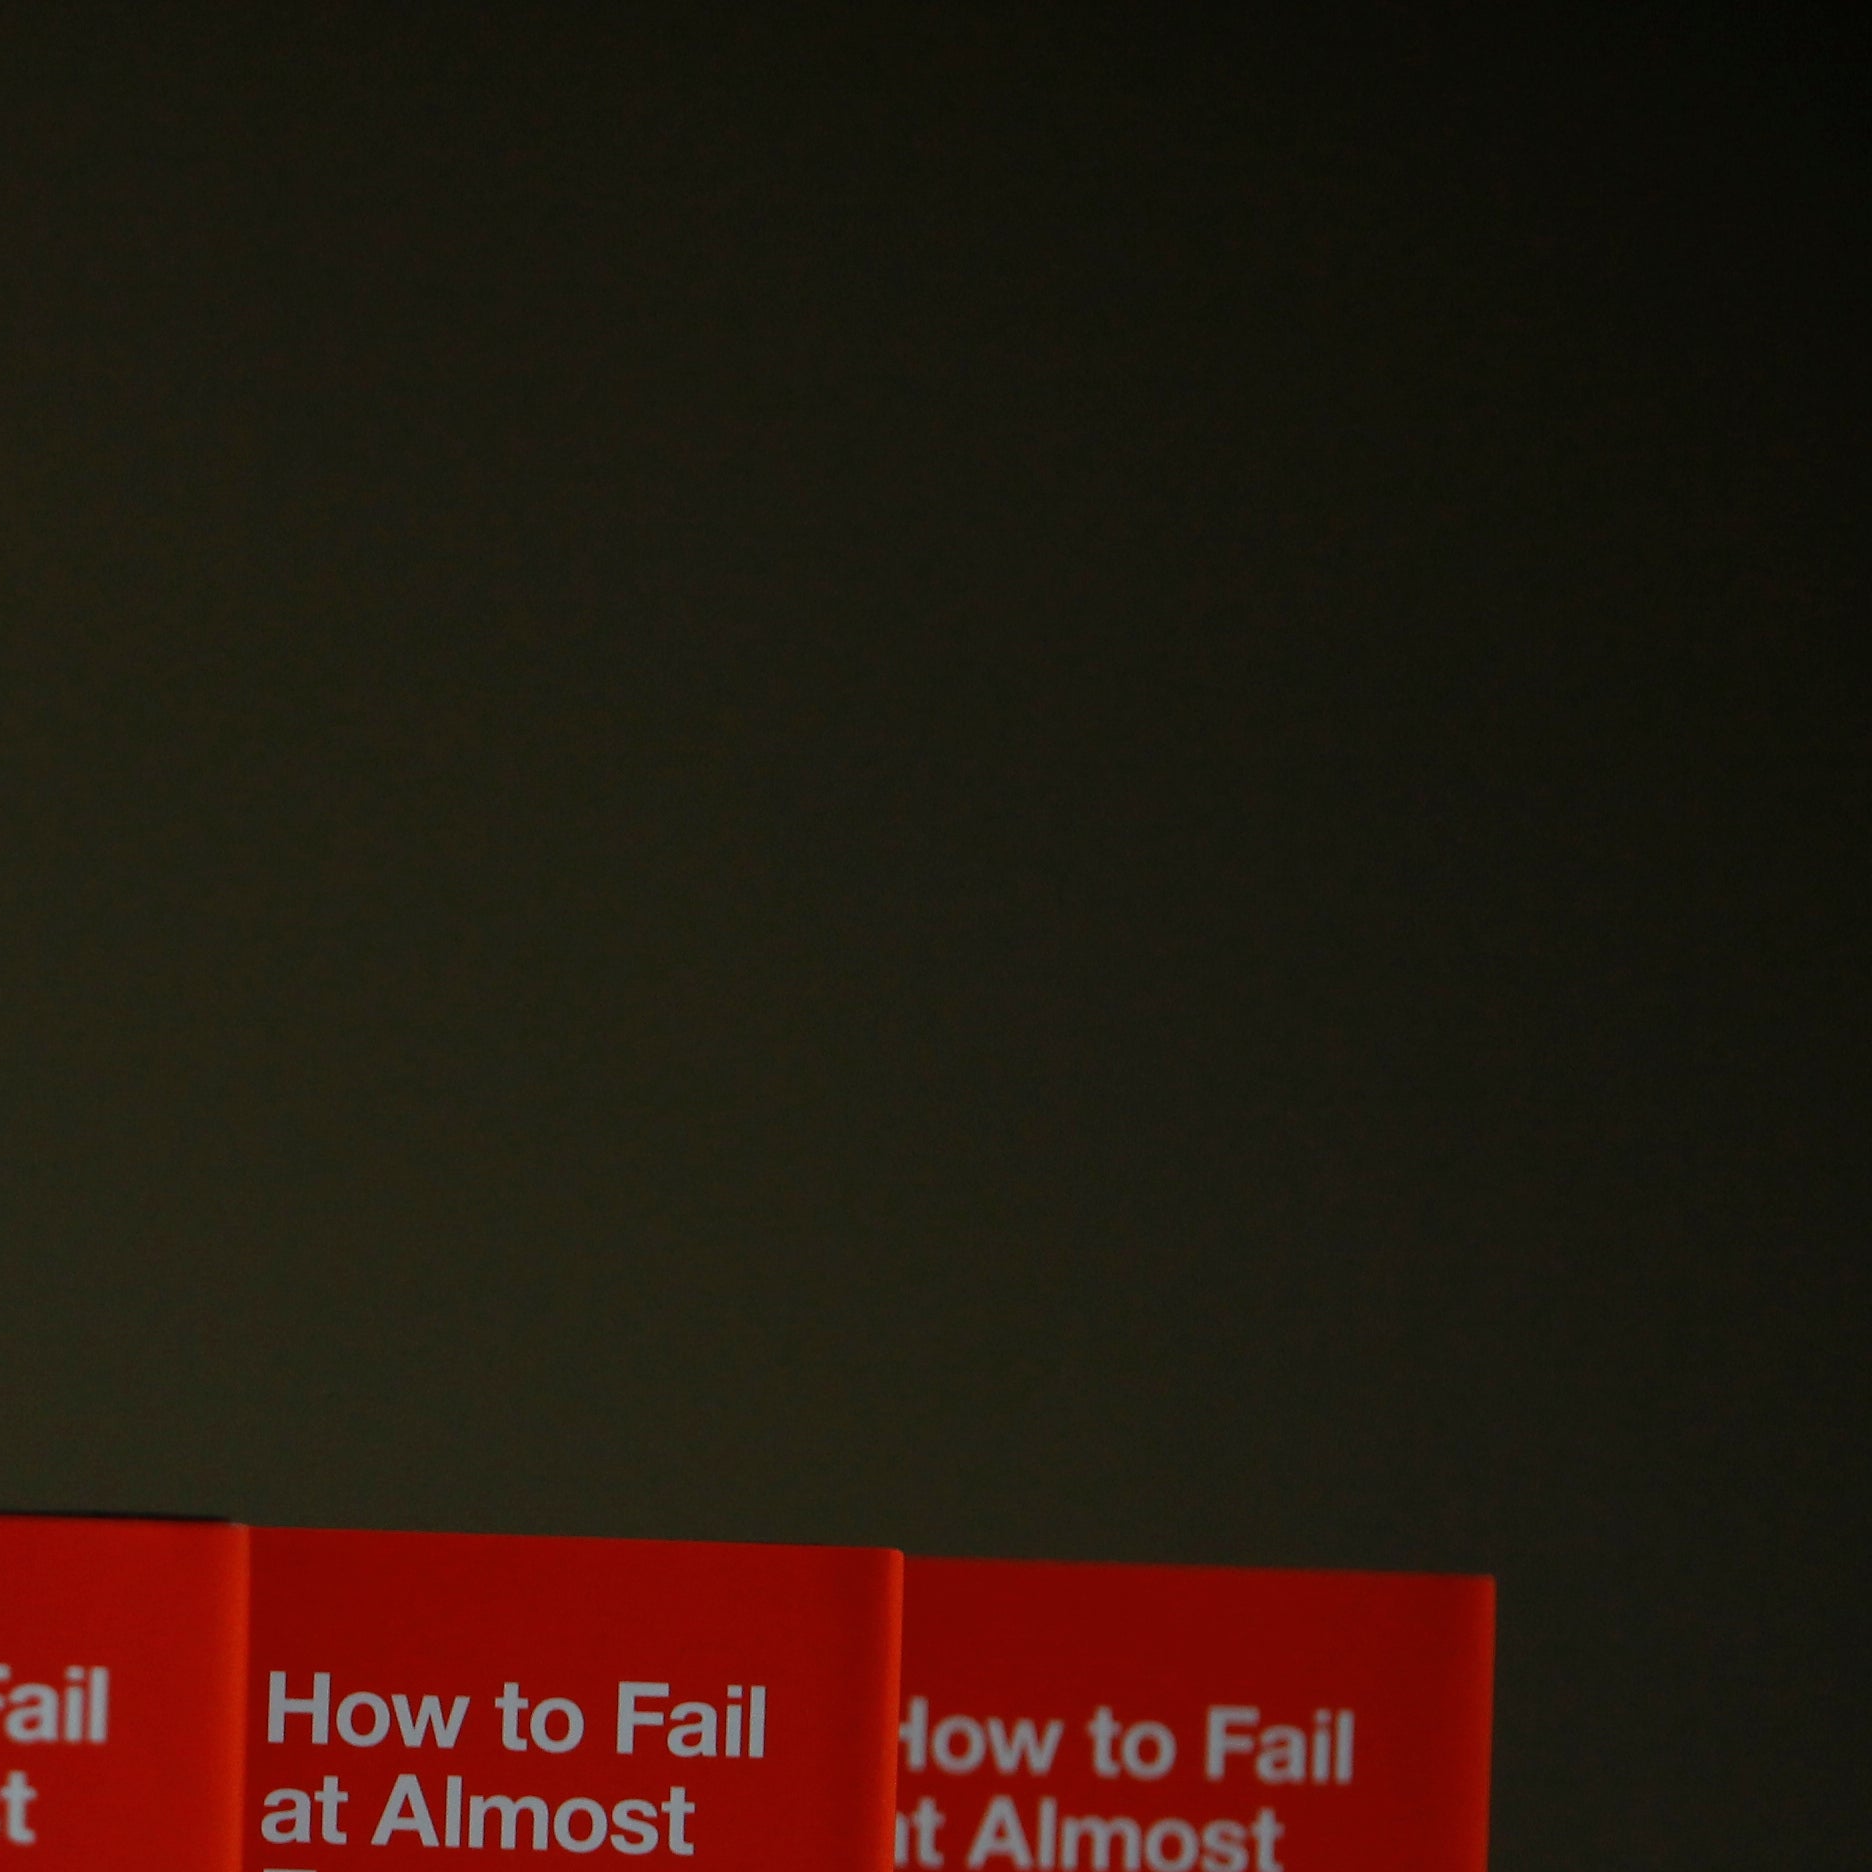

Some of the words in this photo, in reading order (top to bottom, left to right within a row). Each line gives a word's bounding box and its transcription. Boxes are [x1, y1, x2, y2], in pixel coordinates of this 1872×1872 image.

[267, 1670, 471, 1749] How
[494, 1682, 585, 1754] to
[616, 1681, 767, 1759] Fail
[1088, 1707, 1177, 1780] to
[1206, 1706, 1355, 1784] Fail
[261, 1775, 349, 1845] at
[371, 1773, 696, 1856] Almost
